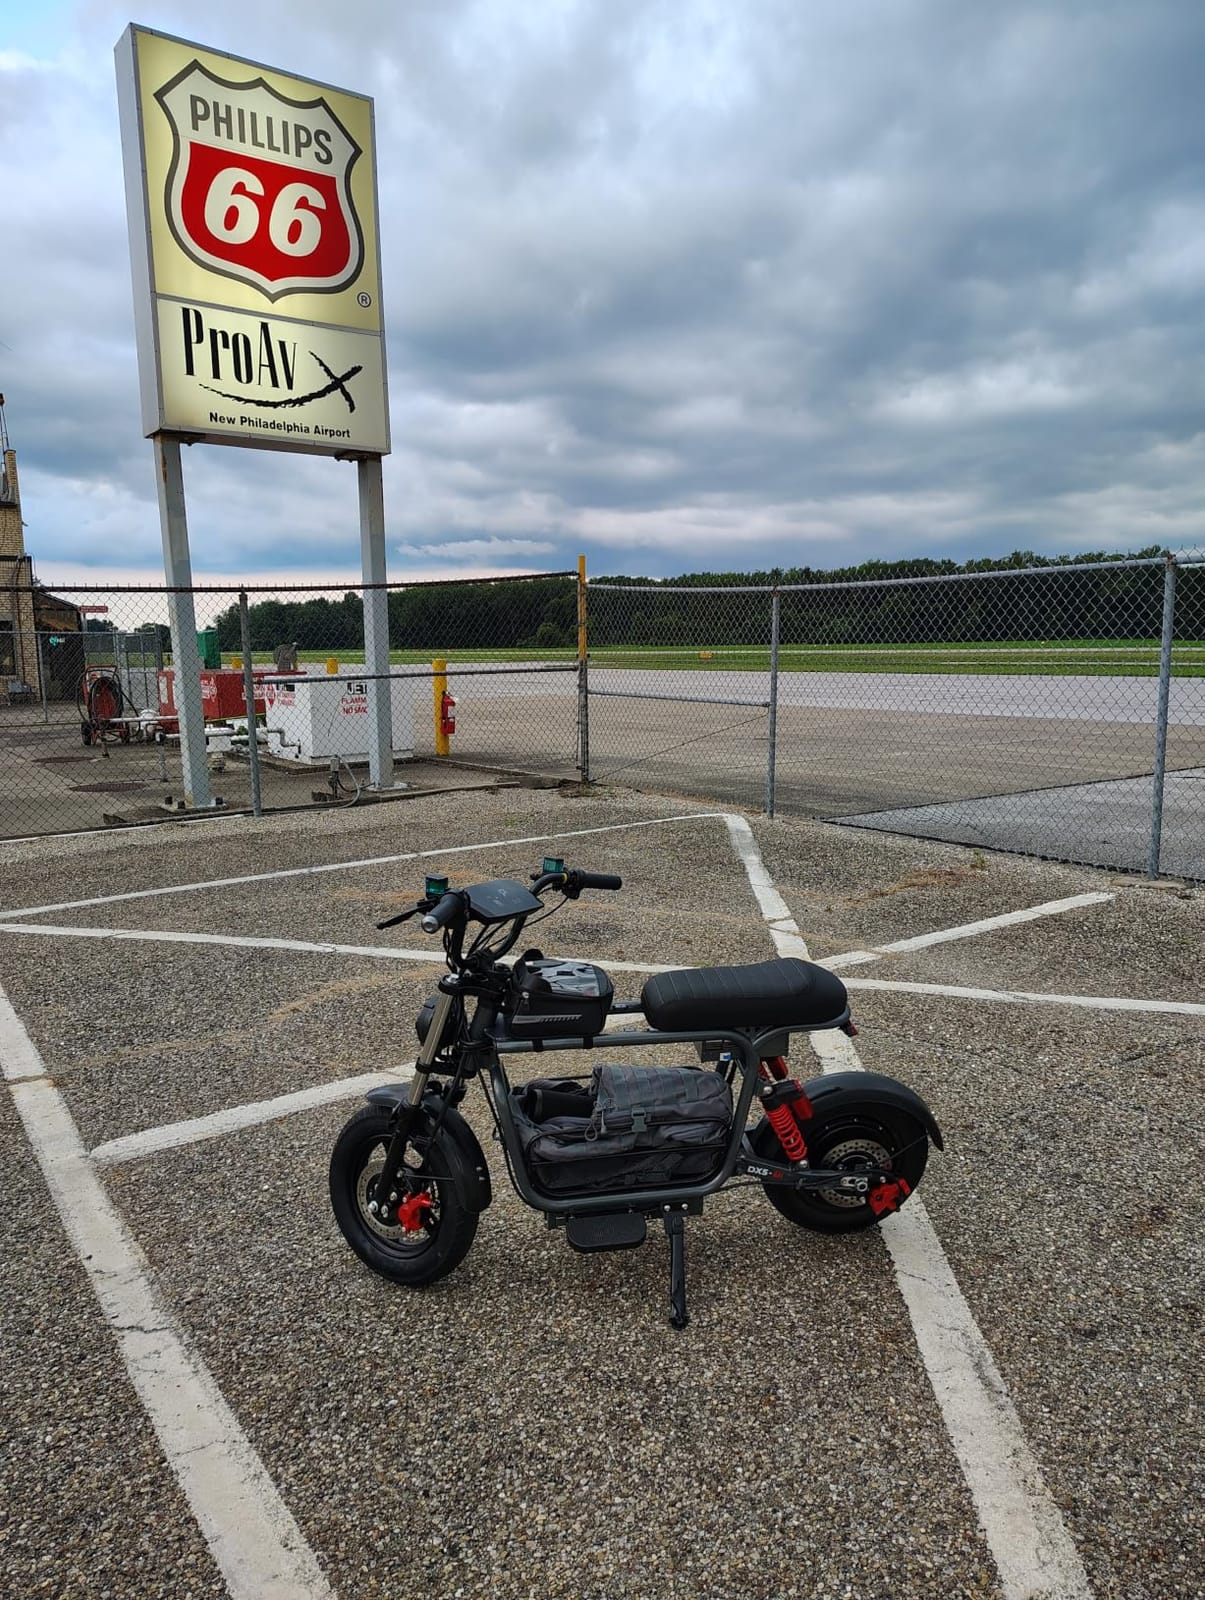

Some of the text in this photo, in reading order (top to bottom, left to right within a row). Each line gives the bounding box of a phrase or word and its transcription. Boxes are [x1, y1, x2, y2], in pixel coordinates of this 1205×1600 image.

[190, 94, 333, 165] PHILLIPS
[204, 167, 327, 257] 66
[181, 307, 298, 390] ProAv
[209, 412, 351, 438] New Philadelphia Airport
[343, 706, 353, 714] NO
[348, 682, 367, 694] JET
